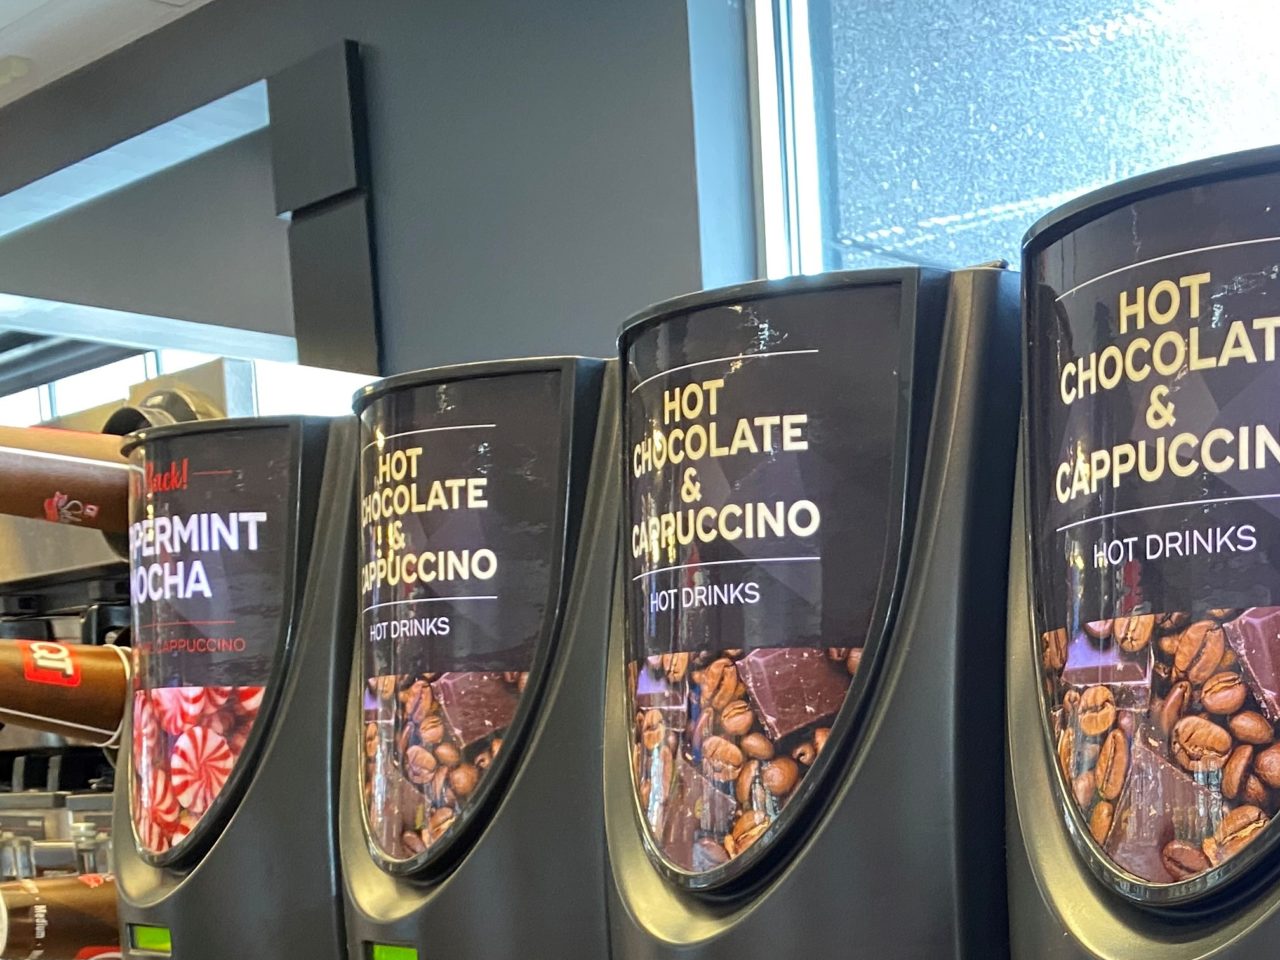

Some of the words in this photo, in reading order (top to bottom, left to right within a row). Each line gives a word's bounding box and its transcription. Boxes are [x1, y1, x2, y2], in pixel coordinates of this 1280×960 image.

[1119, 272, 1211, 335] HOT
[664, 378, 725, 425] HOT
[1145, 384, 1176, 430] &
[378, 447, 423, 484] HOT
[633, 414, 809, 479] CHOCOLATE
[680, 466, 702, 503] &
[632, 500, 821, 559] CAPPUCCINO
[1093, 537, 1138, 568] HOT
[1145, 524, 1257, 560] DRINKS
[650, 589, 678, 612] HOT
[682, 582, 760, 608] DRINKS
[370, 623, 388, 641] HOT
[391, 616, 450, 639] DRINKS
